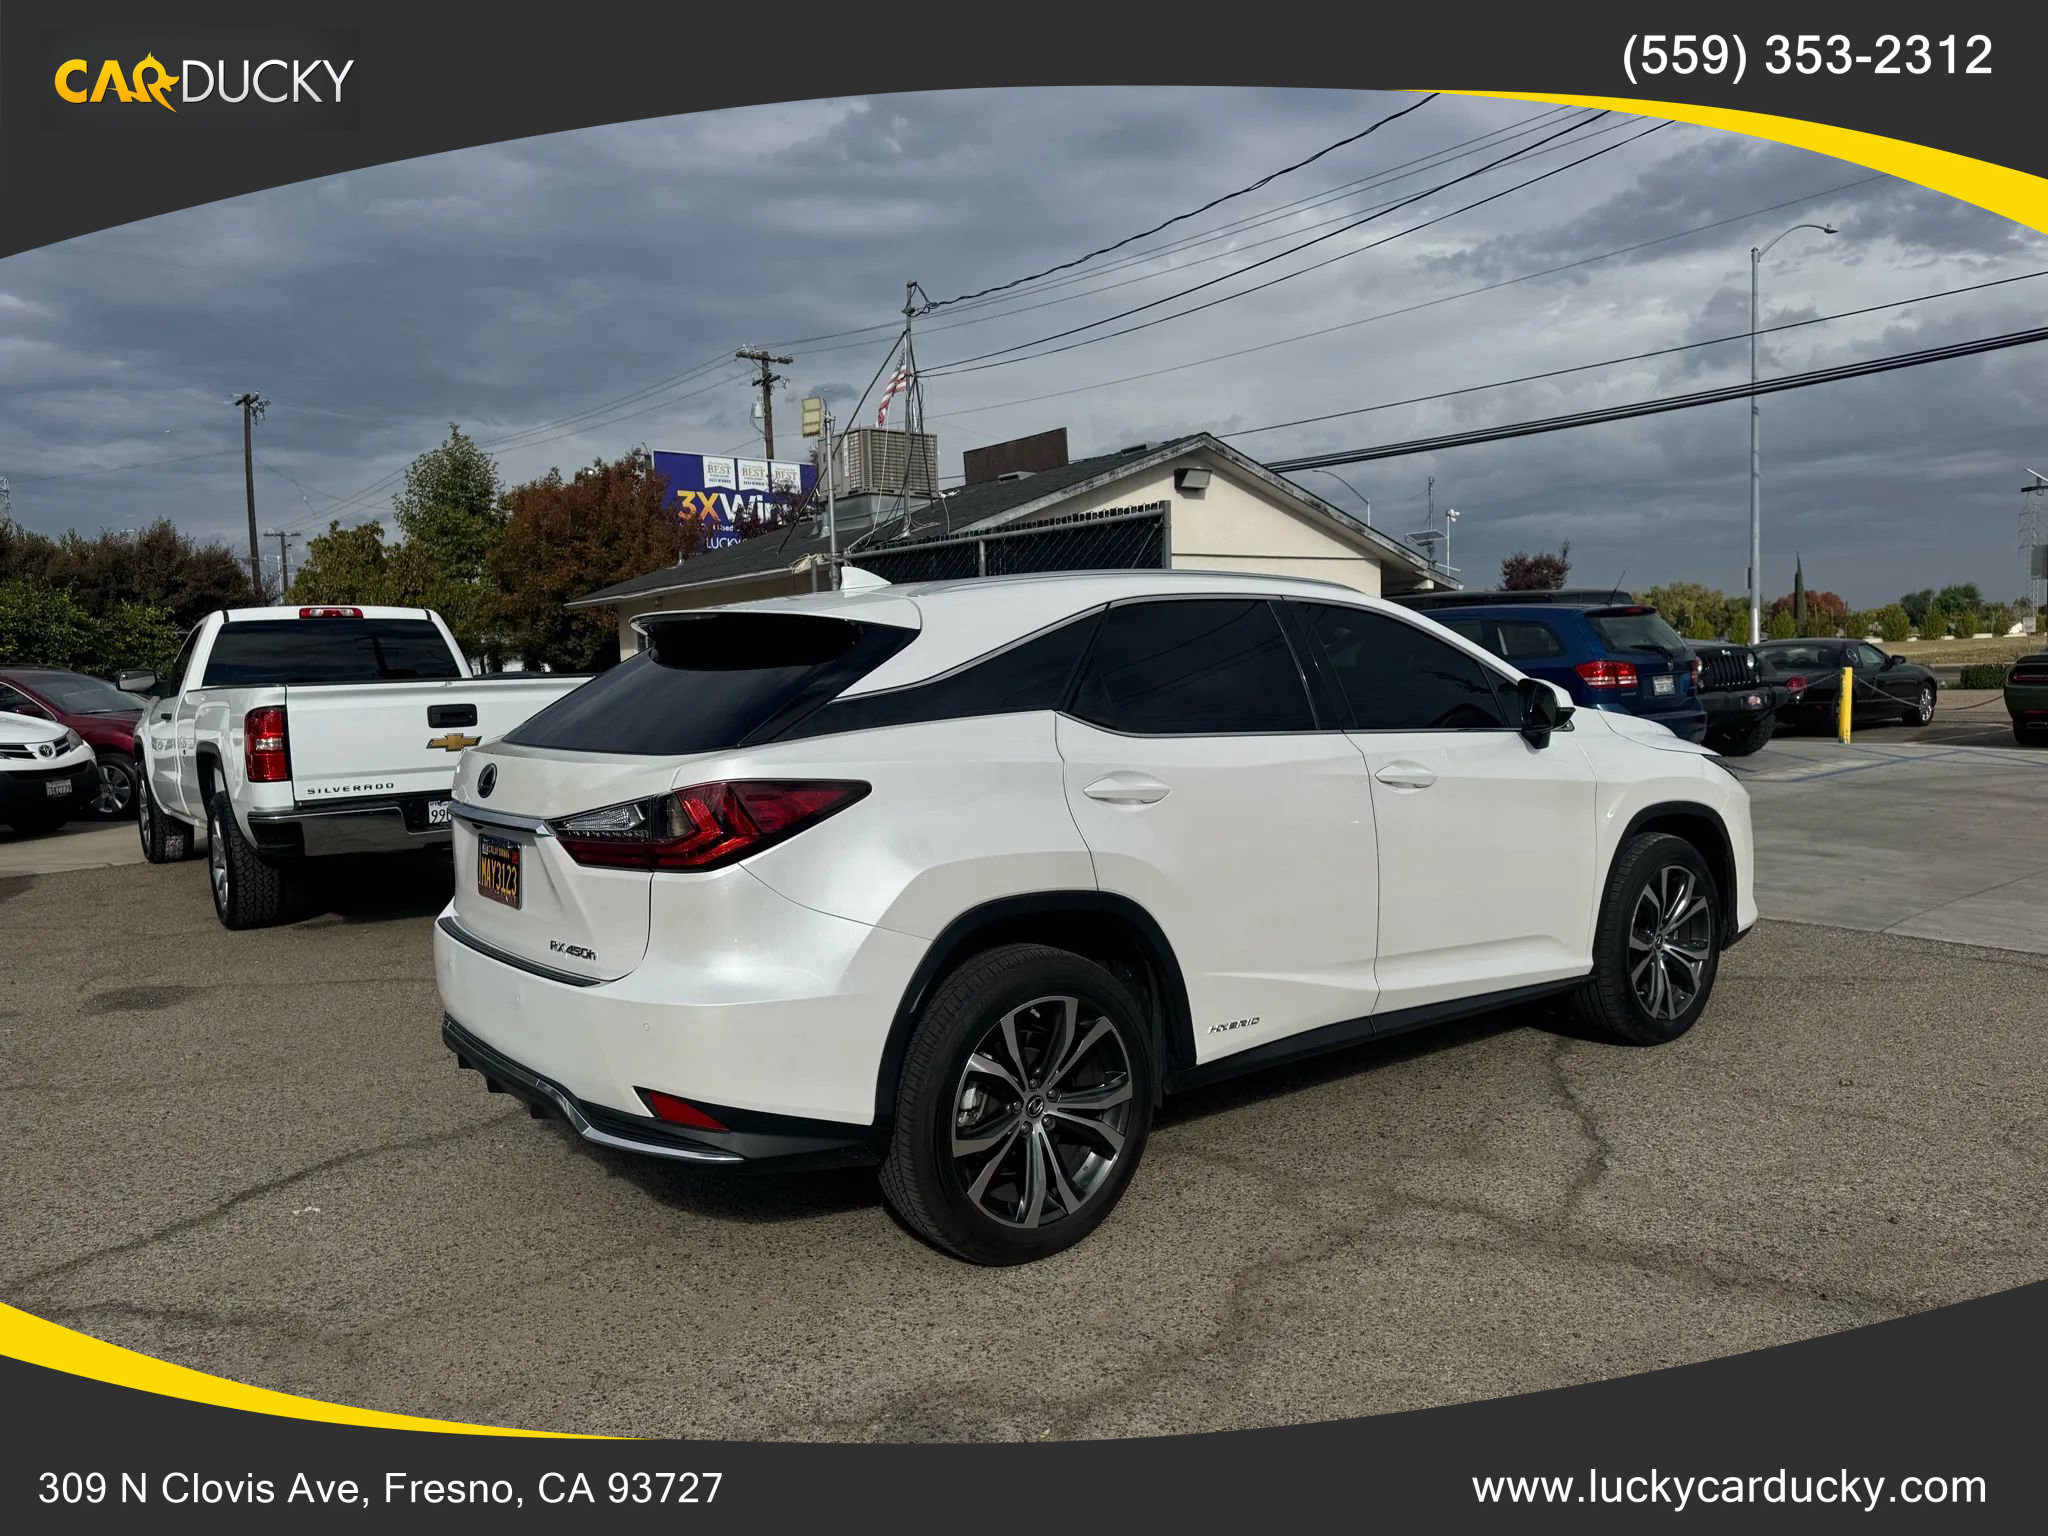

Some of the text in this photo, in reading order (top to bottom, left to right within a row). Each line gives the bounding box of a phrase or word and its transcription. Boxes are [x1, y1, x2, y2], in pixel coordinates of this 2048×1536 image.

[708, 464, 732, 475] BEST
[742, 467, 766, 478] BEST
[775, 470, 798, 481] BEST
[307, 782, 395, 795] SILVERADO
[481, 857, 517, 896] MAY3123
[1208, 1016, 1260, 1034] HYBRID
